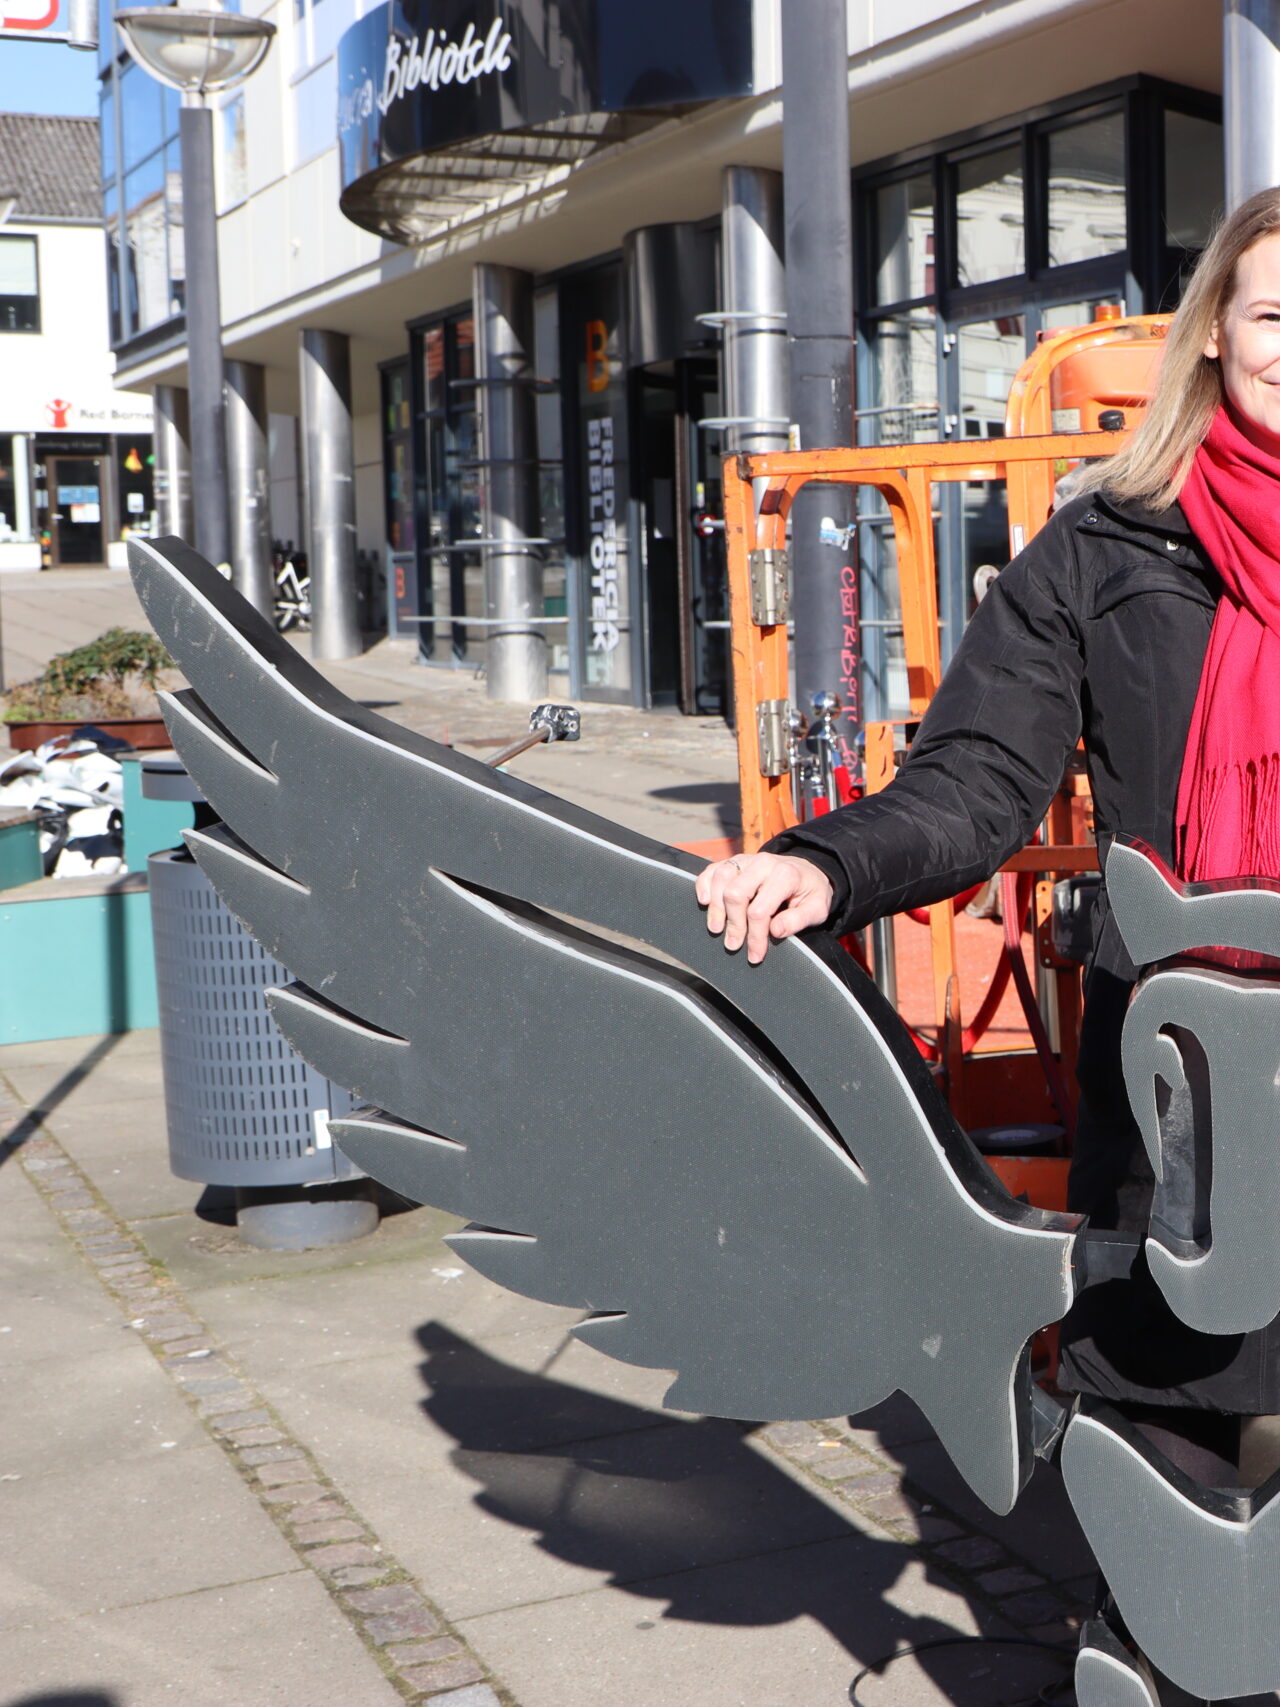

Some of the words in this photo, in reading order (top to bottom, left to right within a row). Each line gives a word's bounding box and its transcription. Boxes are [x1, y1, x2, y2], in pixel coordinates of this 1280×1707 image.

[111, 409, 153, 420] Barne
[587, 419, 608, 651] BIBLIOTEK
[600, 416, 620, 652] FREDERICIA
